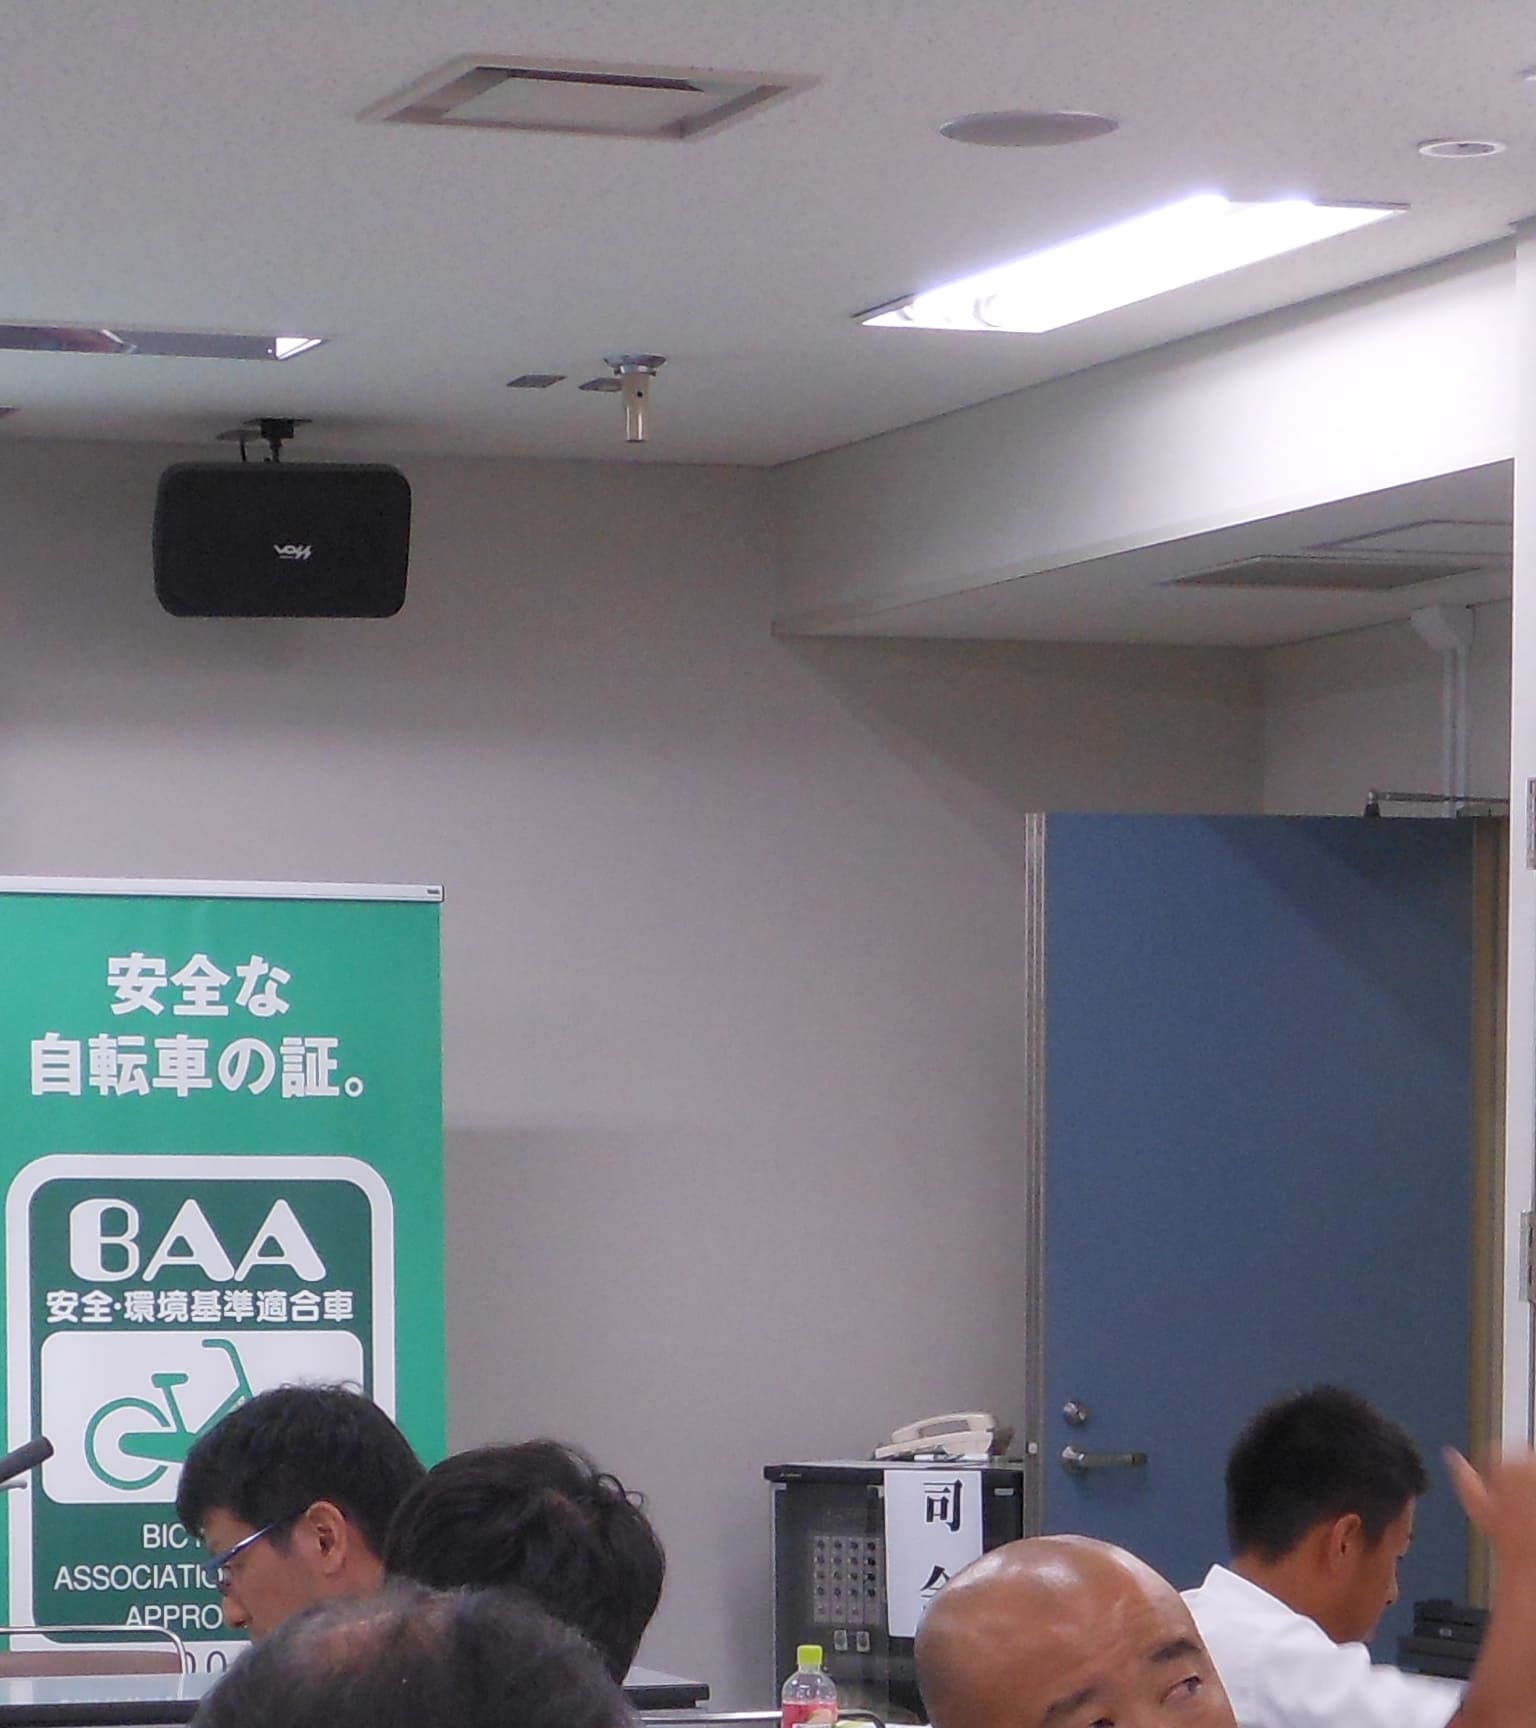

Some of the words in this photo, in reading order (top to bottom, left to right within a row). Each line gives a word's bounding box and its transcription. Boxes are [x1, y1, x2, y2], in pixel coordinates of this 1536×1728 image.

[107, 953, 291, 1018] 安全な
[30, 1033, 364, 1098] 自転車の証。
[69, 1198, 327, 1281] BAA
[46, 1290, 354, 1324] 安全・環境基準適合車
